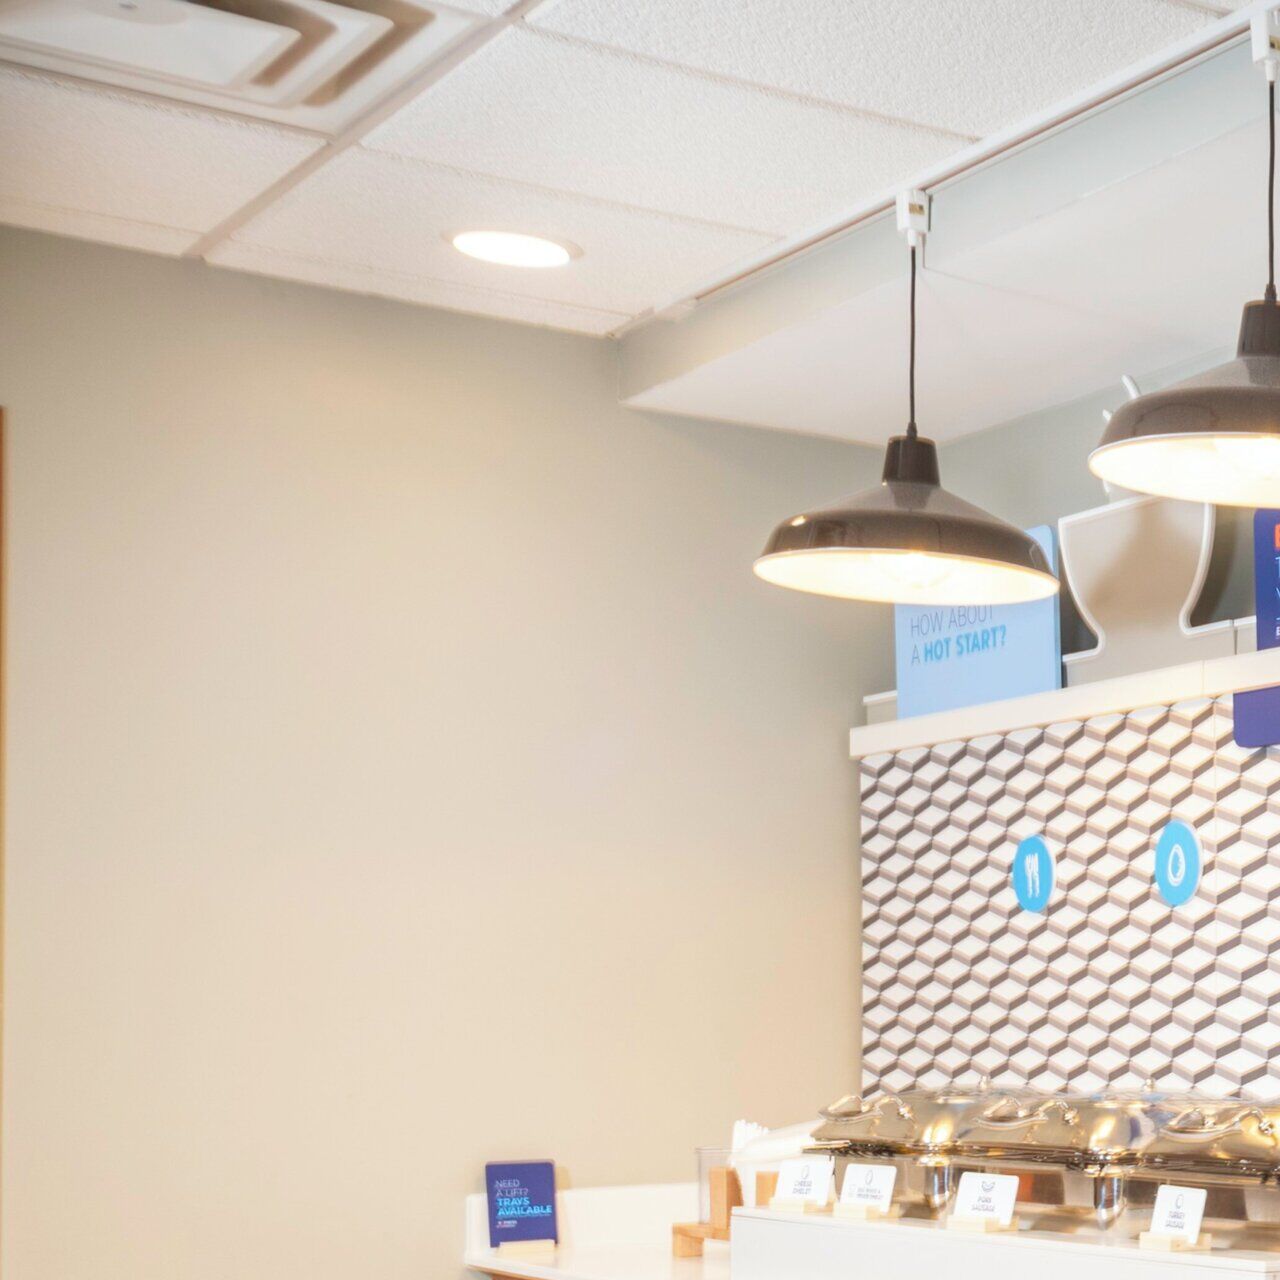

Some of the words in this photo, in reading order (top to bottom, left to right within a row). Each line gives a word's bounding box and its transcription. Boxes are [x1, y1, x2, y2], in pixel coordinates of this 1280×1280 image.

[910, 610, 944, 638] HOW
[911, 645, 921, 666] A
[924, 637, 951, 663] HOT
[955, 624, 1007, 656] START?
[495, 1179, 520, 1188] NEED
[496, 1189, 503, 1197] A
[496, 1197, 530, 1207] TRAYS
[497, 1205, 553, 1216] AVAILABLE
